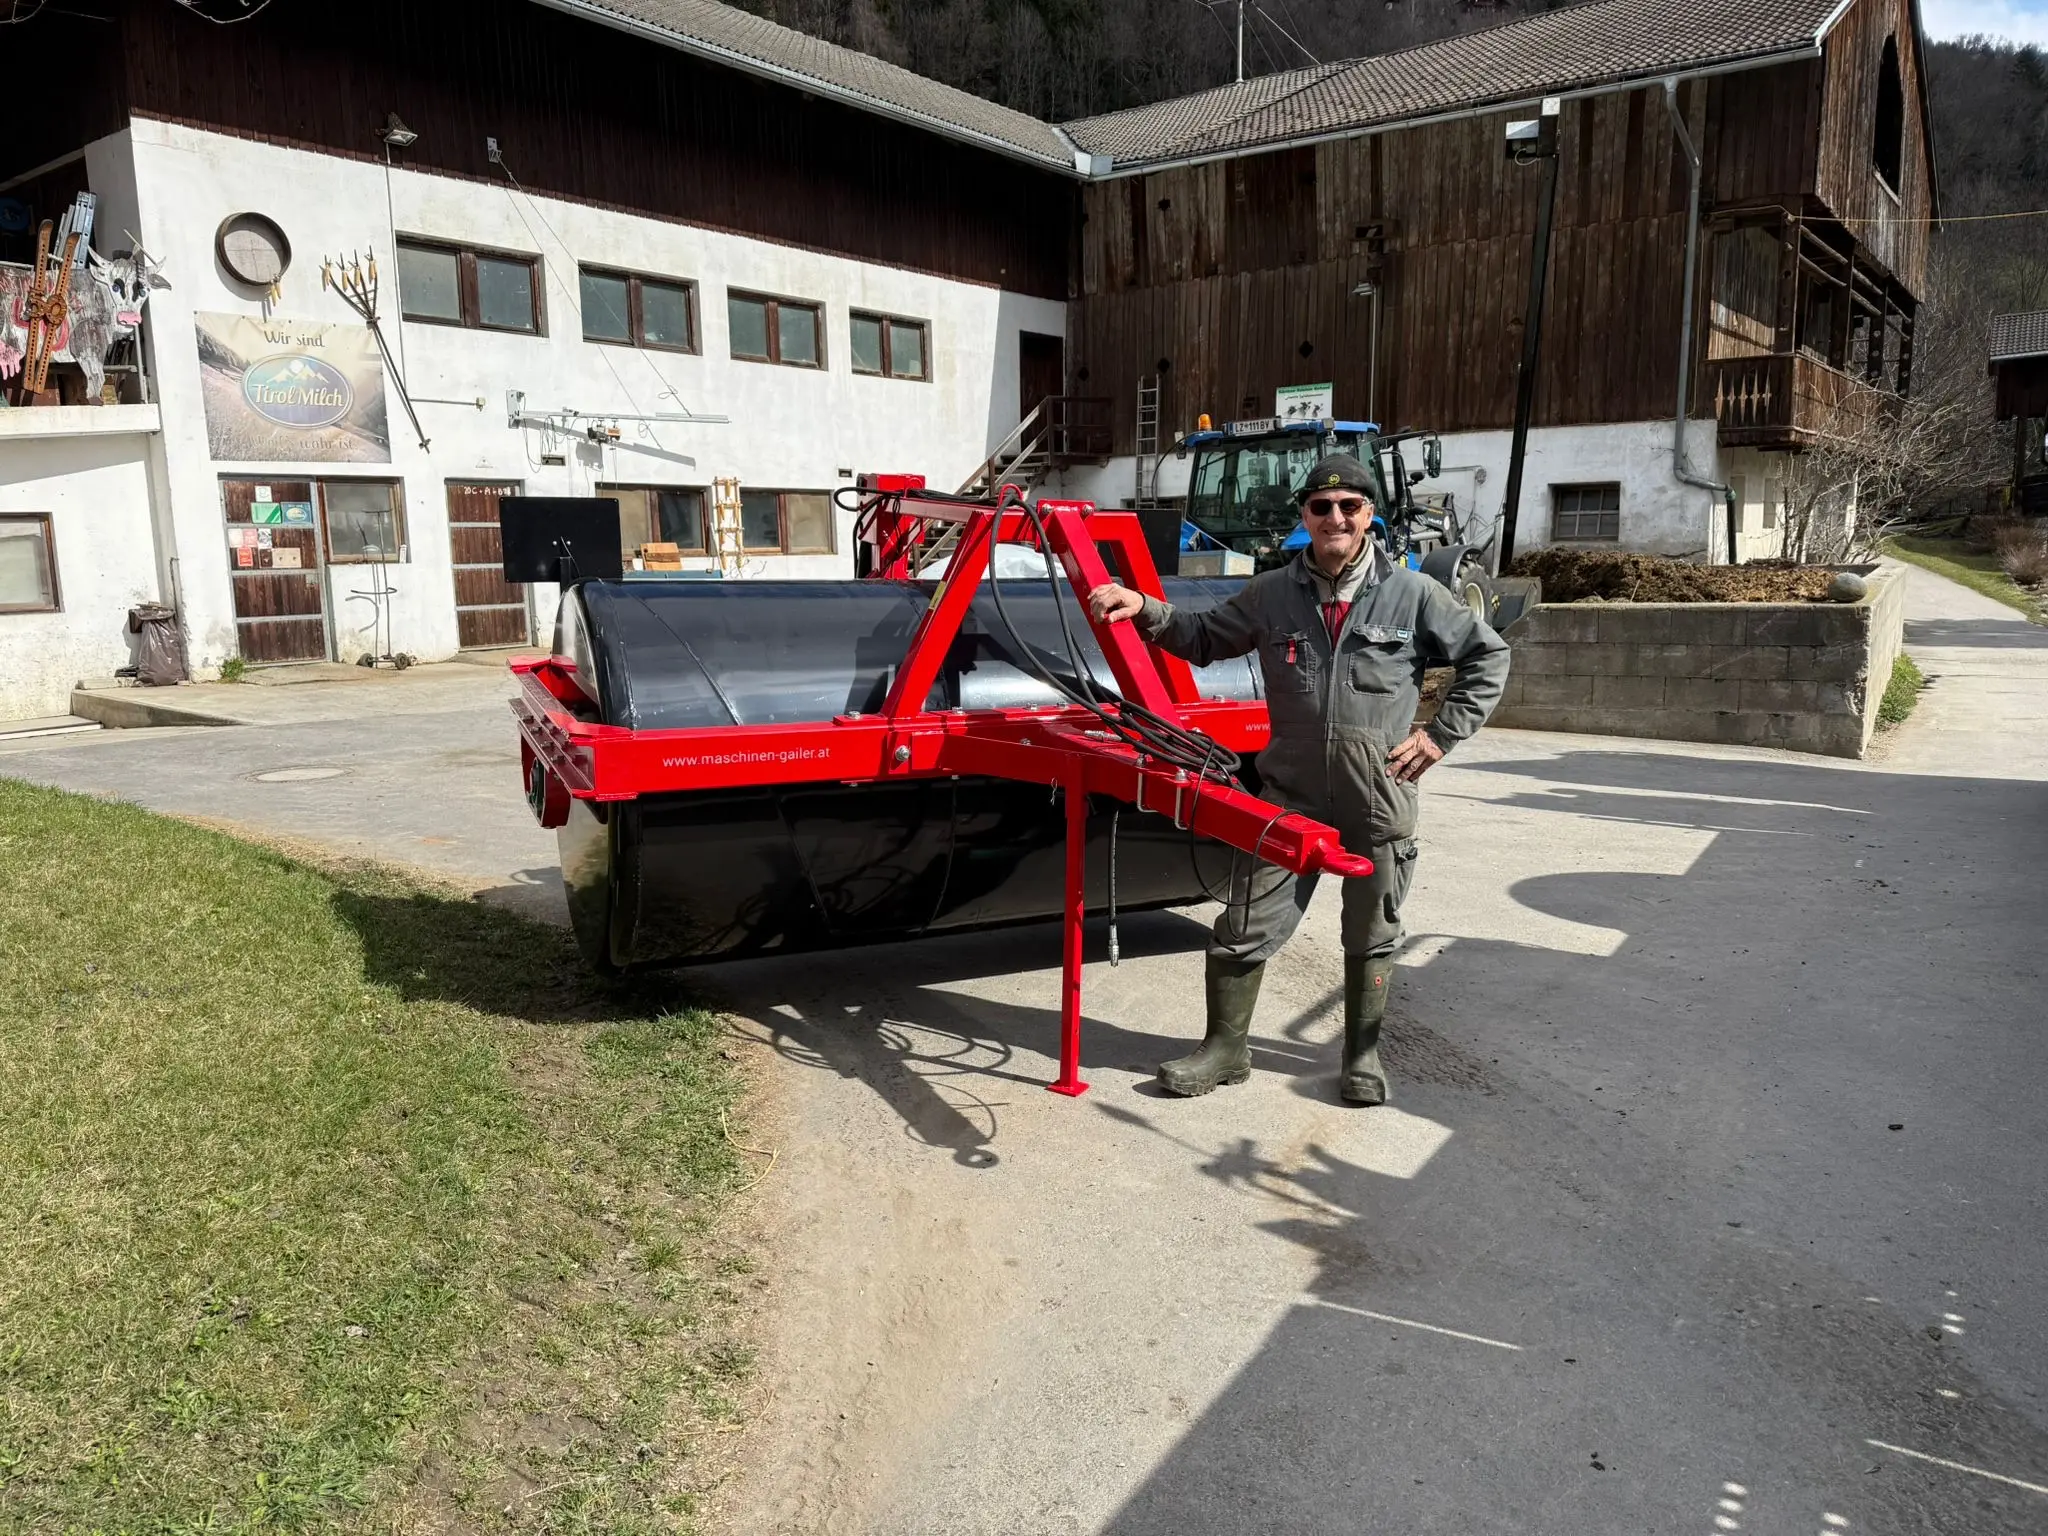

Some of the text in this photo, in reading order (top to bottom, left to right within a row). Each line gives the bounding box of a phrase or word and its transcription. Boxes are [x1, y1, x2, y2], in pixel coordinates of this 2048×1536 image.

[264, 330, 324, 347] Wir sind
[252, 383, 344, 407] Tirol Milch
[1235, 423, 1244, 432] LZ
[300, 436, 333, 449] wahr
[663, 746, 830, 767] www.maschinen-gailer.at
